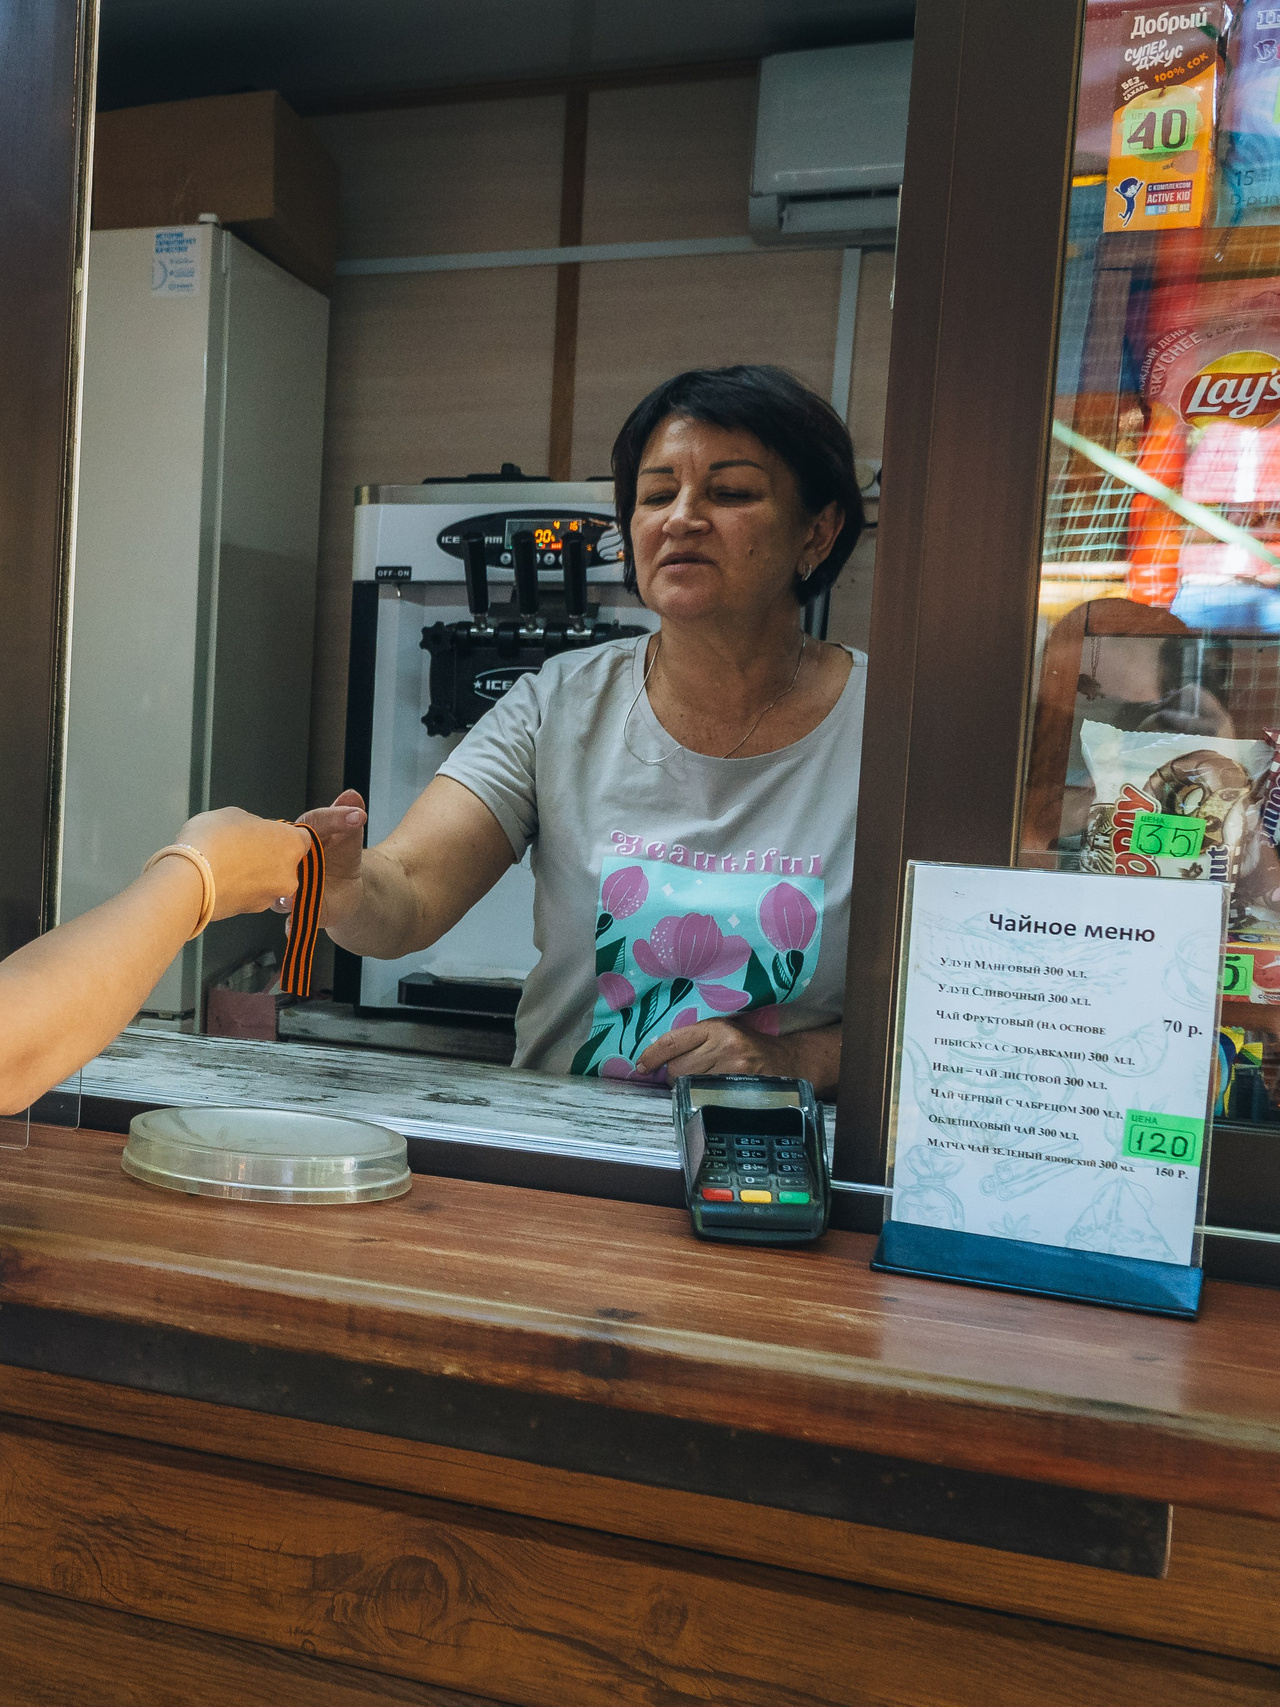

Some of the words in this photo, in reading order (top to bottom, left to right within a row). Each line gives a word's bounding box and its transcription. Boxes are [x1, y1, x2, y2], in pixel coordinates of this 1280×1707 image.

[1130, 6, 1208, 39] Добрый
[1124, 39, 1167, 66] СУПЕР
[1136, 45, 1183, 72] ДЖУС
[1154, 67, 1185, 83] 100%
[1121, 76, 1140, 90] БЕЗ
[1127, 109, 1187, 150] 40
[1147, 192, 1175, 203] ACTIVE
[1177, 191, 1190, 201] KID
[1158, 329, 1187, 349] ДЕНЬ
[1150, 332, 1203, 397] ВКУСНЕЕ
[1185, 367, 1280, 420] Lay's
[441, 536, 460, 544] ICE
[485, 680, 513, 690] ICE
[1140, 815, 1164, 825] ЦЕНА
[1139, 824, 1201, 858] 35
[610, 830, 822, 875] Beautiful
[989, 913, 1077, 937] Чайное
[1084, 924, 1156, 942] меню
[1043, 966, 1064, 976] 300
[1048, 993, 1068, 1004] 300
[1163, 1019, 1182, 1033] 70
[1188, 1025, 1203, 1038] р.
[1088, 1052, 1109, 1062] 300
[1064, 1076, 1084, 1087] 300
[1079, 1105, 1099, 1116] 300
[1131, 1114, 1158, 1125] ЦЕНА
[1038, 1127, 1057, 1138] 300
[1136, 1131, 1189, 1158] 120
[1098, 1160, 1118, 1170] 300
